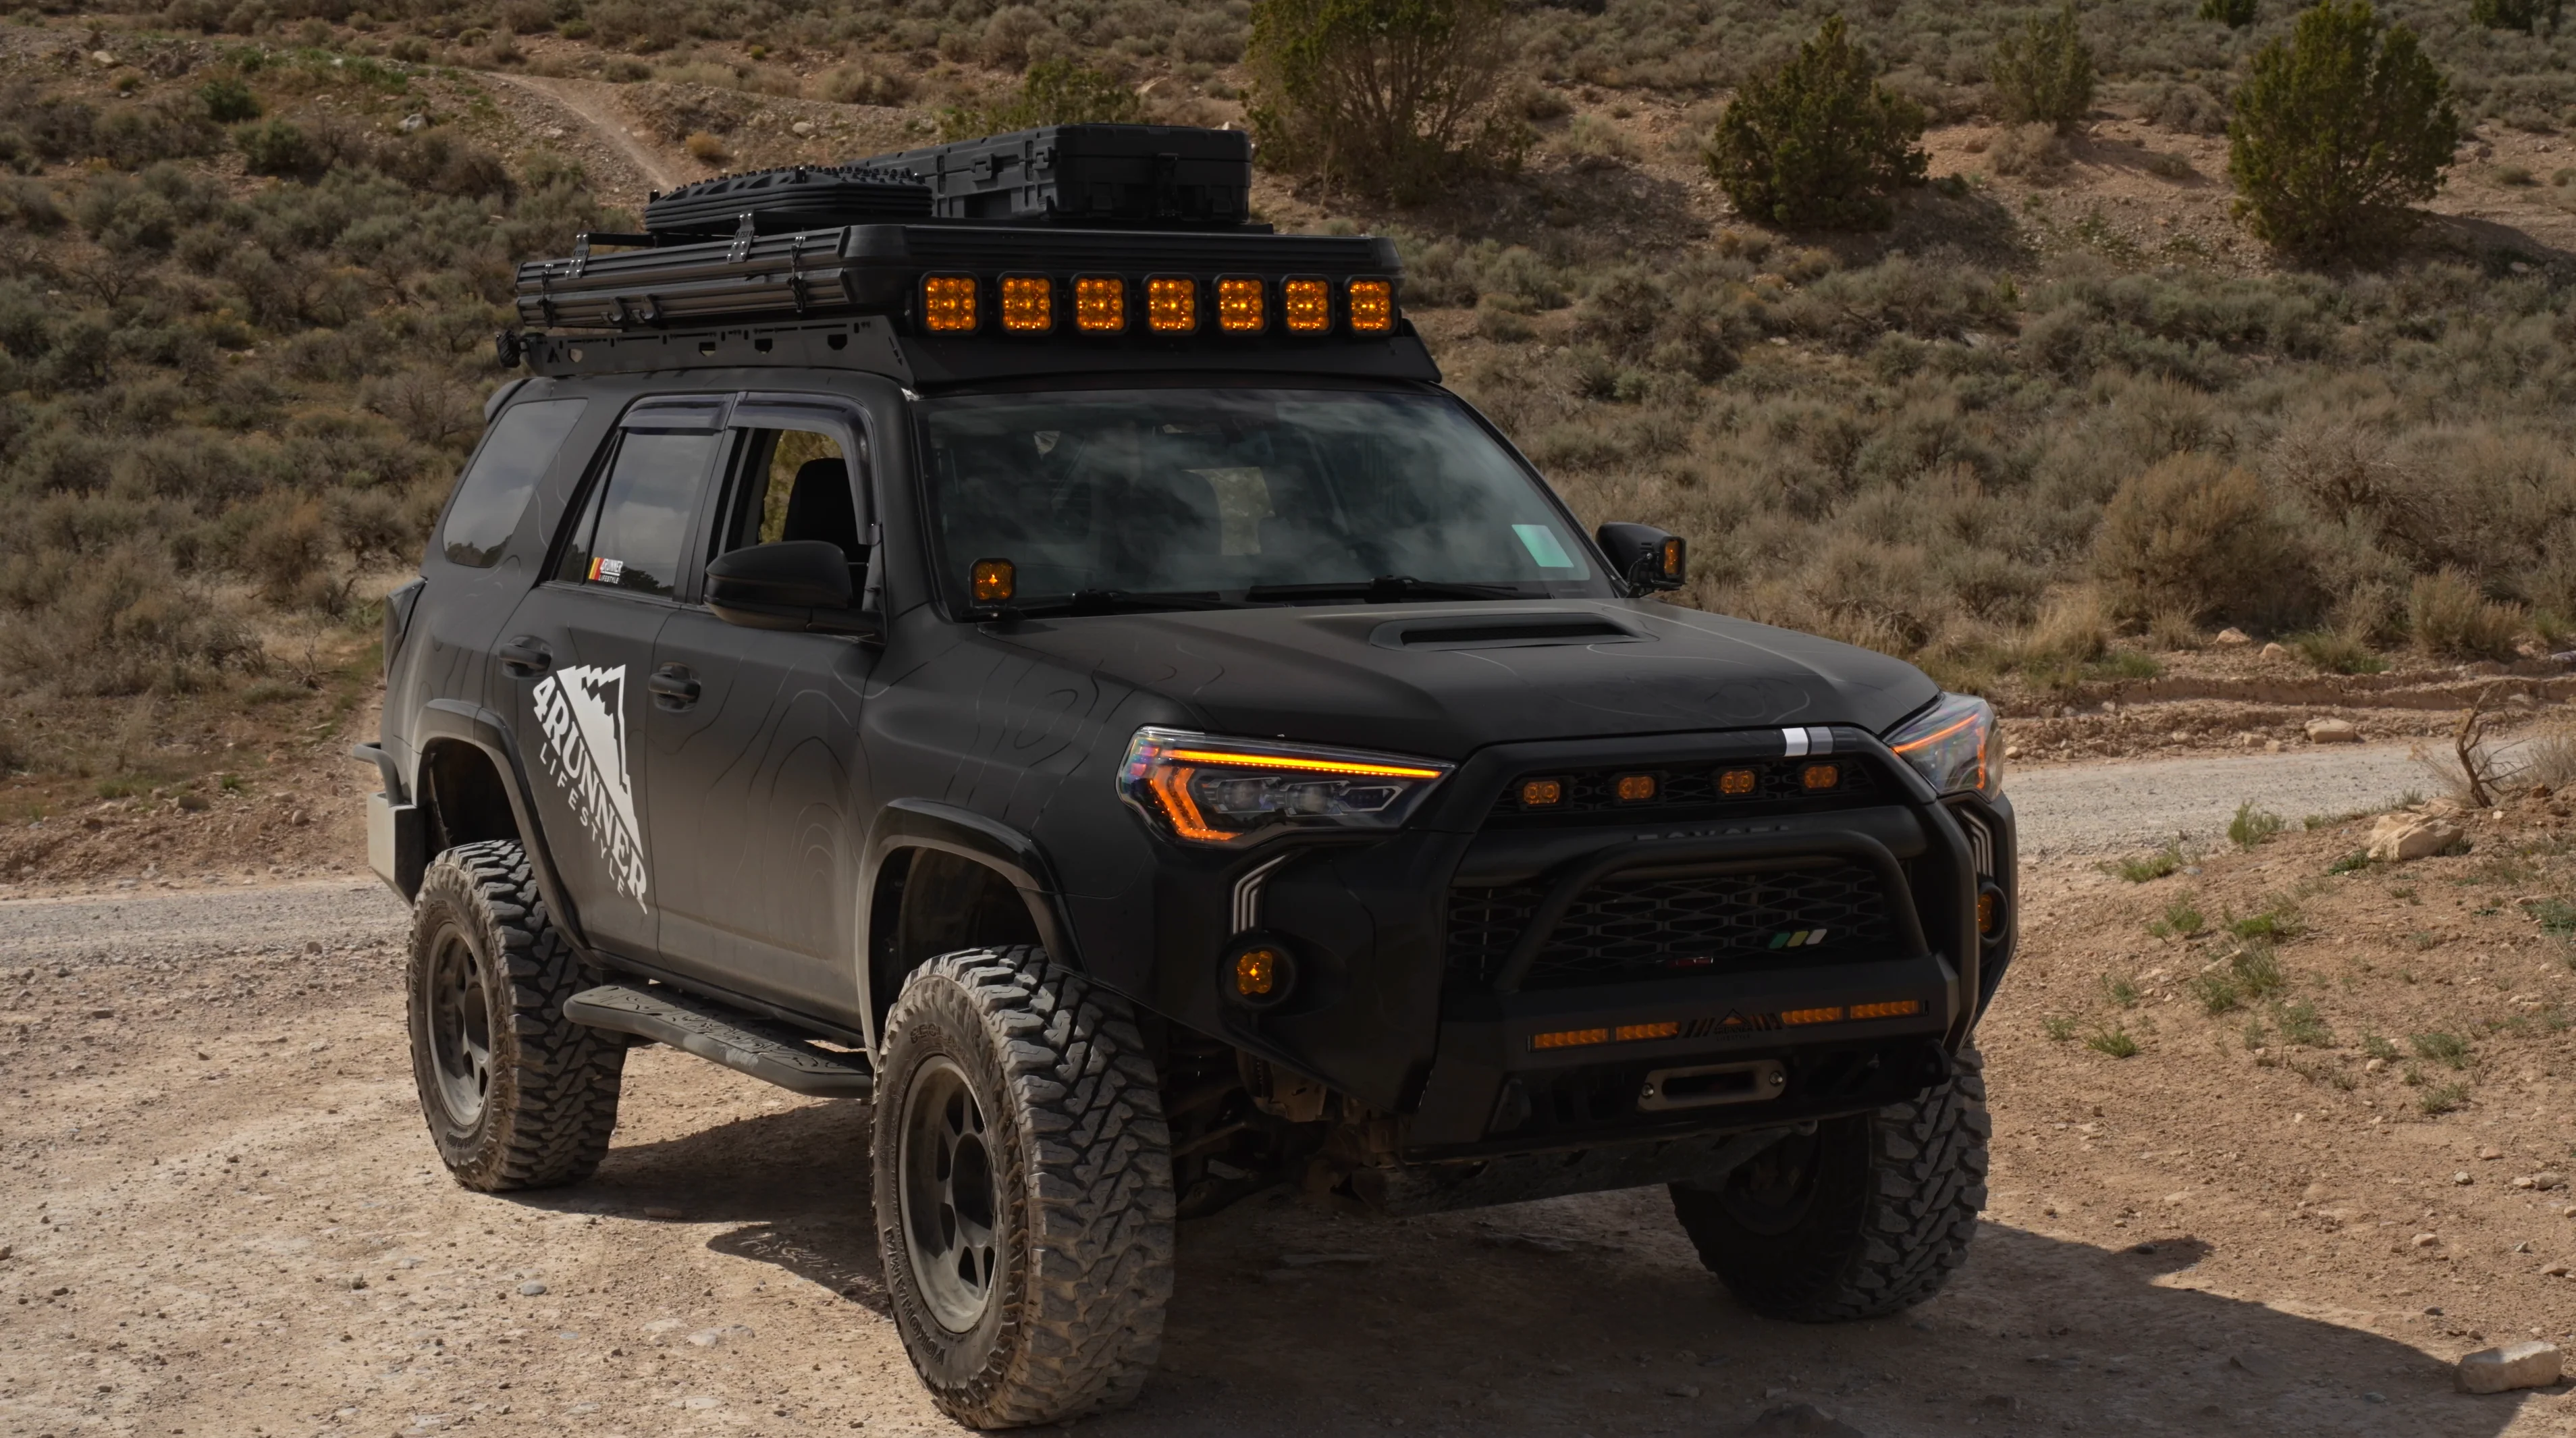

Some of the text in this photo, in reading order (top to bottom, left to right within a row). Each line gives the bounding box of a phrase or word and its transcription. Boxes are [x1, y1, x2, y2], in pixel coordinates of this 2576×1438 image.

[599, 575, 620, 584] LIFESTYLE
[533, 676, 647, 914] 4RUNNER
[540, 743, 624, 897] LIFESTYLE
[1713, 1024, 1753, 1034] 4RUNNER
[1717, 1034, 1750, 1042] LIFESTYLE
[884, 1226, 946, 1366] YOKOHAMA
